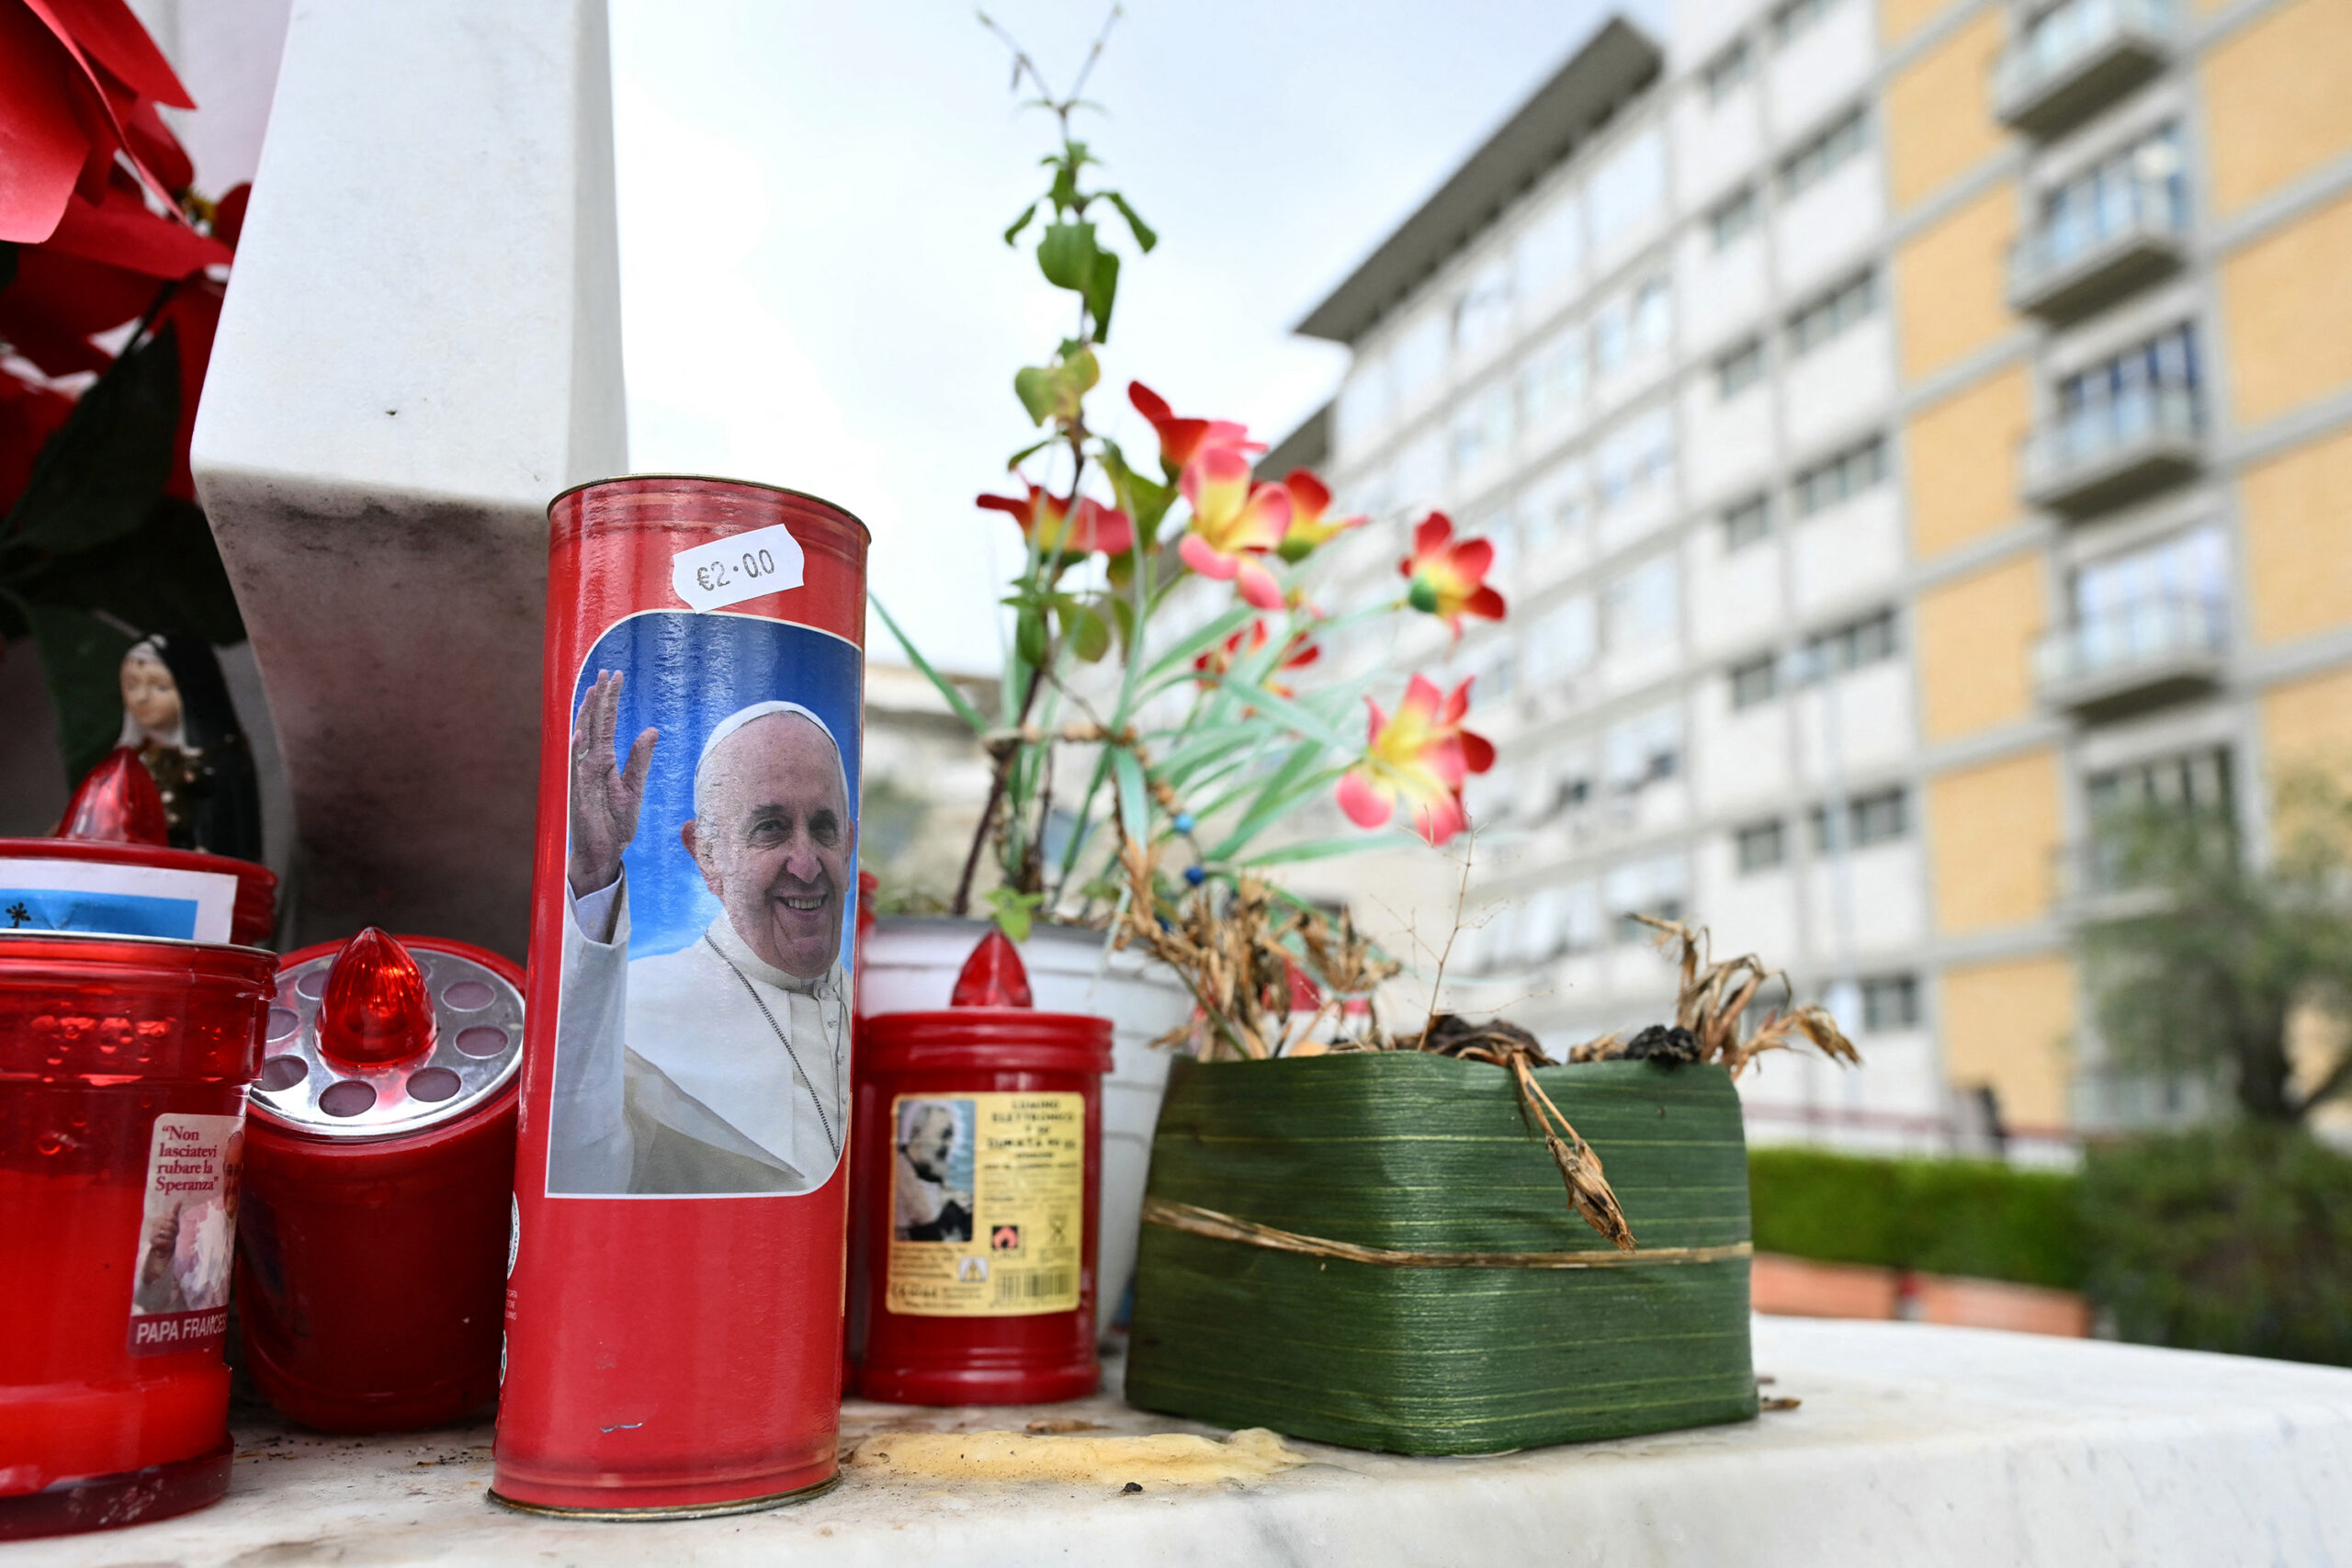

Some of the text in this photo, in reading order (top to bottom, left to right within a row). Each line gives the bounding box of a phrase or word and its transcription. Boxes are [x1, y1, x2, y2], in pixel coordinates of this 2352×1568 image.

[159, 1142, 217, 1158] lasciatevi
[157, 1160, 212, 1175] rubare la
[136, 1321, 179, 1344] PAPA
